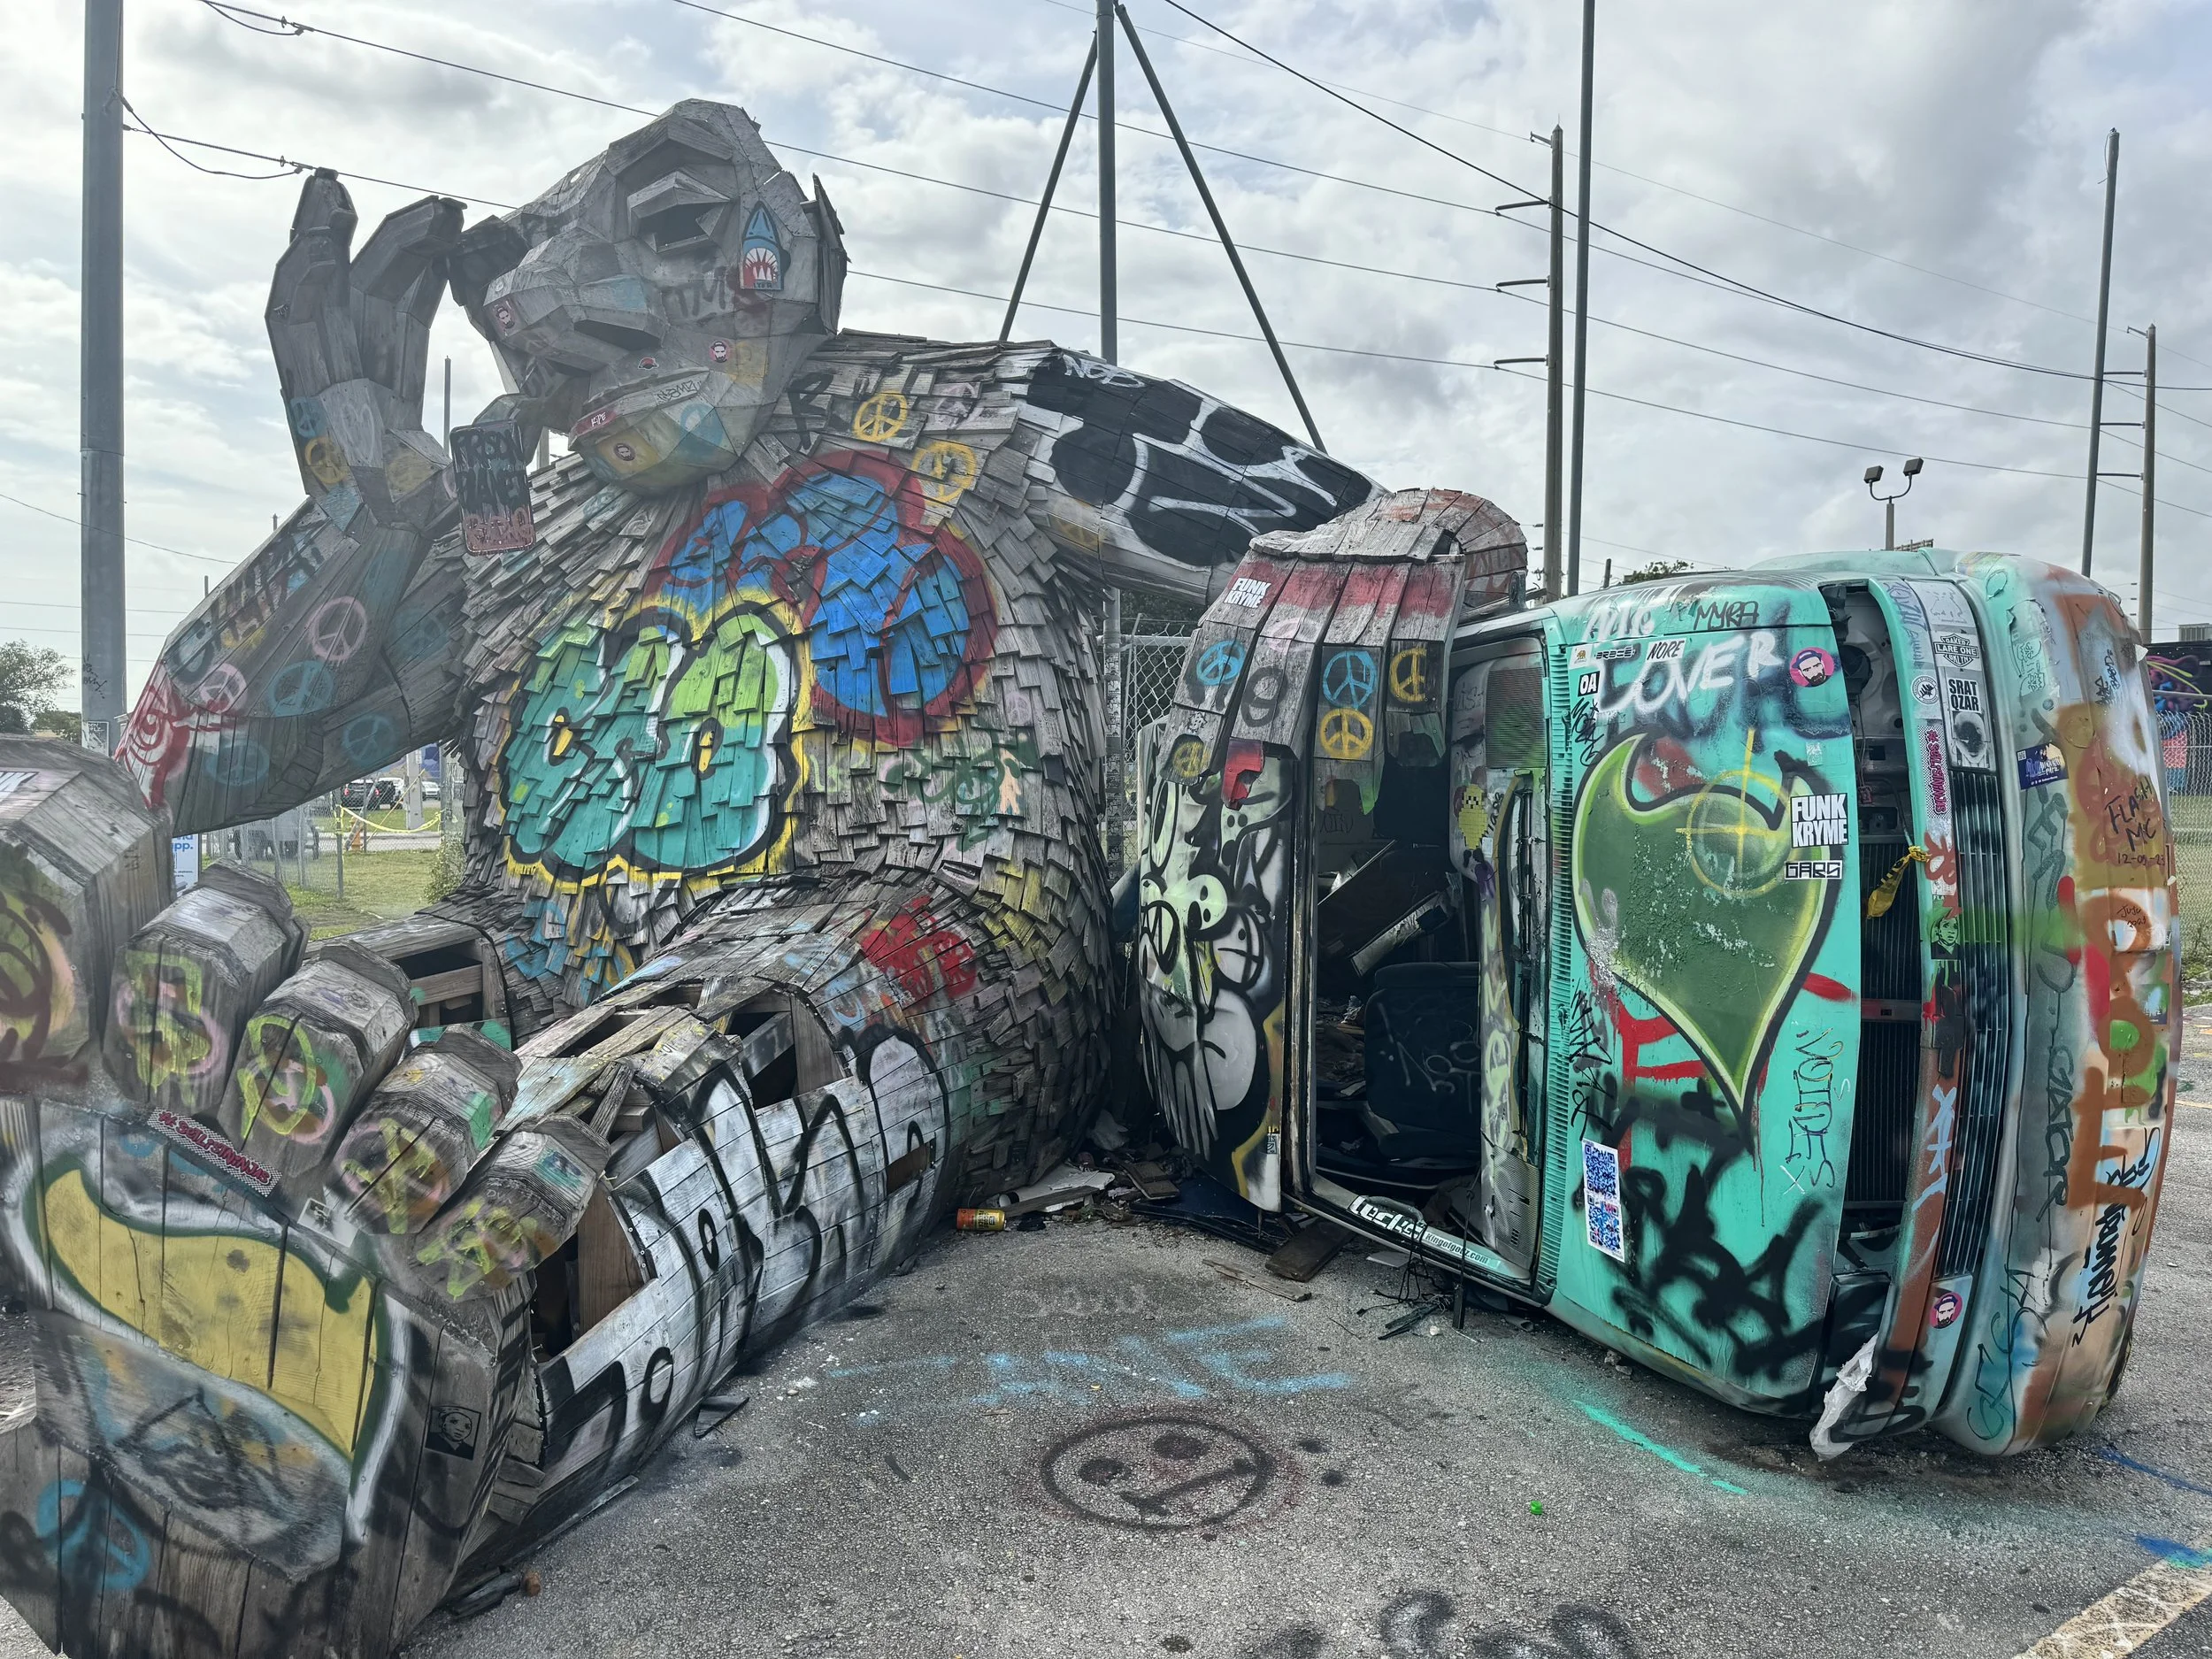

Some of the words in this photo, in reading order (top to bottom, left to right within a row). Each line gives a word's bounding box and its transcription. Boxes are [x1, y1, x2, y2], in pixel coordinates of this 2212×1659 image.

[1231, 577, 1272, 596] FUNK
[1223, 590, 1264, 609] KRYME
[1693, 600, 1760, 631] MYRA
[1646, 639, 1685, 661] NORE
[1959, 647, 1977, 657] ONE
[1579, 672, 1597, 695] OA
[1948, 679, 1978, 697] SRAT
[1950, 694, 1979, 711] QZAR
[1791, 793, 1847, 823] FUNK
[2104, 776, 2153, 834] FLASH
[1792, 818, 1848, 849] KRYME
[2124, 818, 2156, 852] MC
